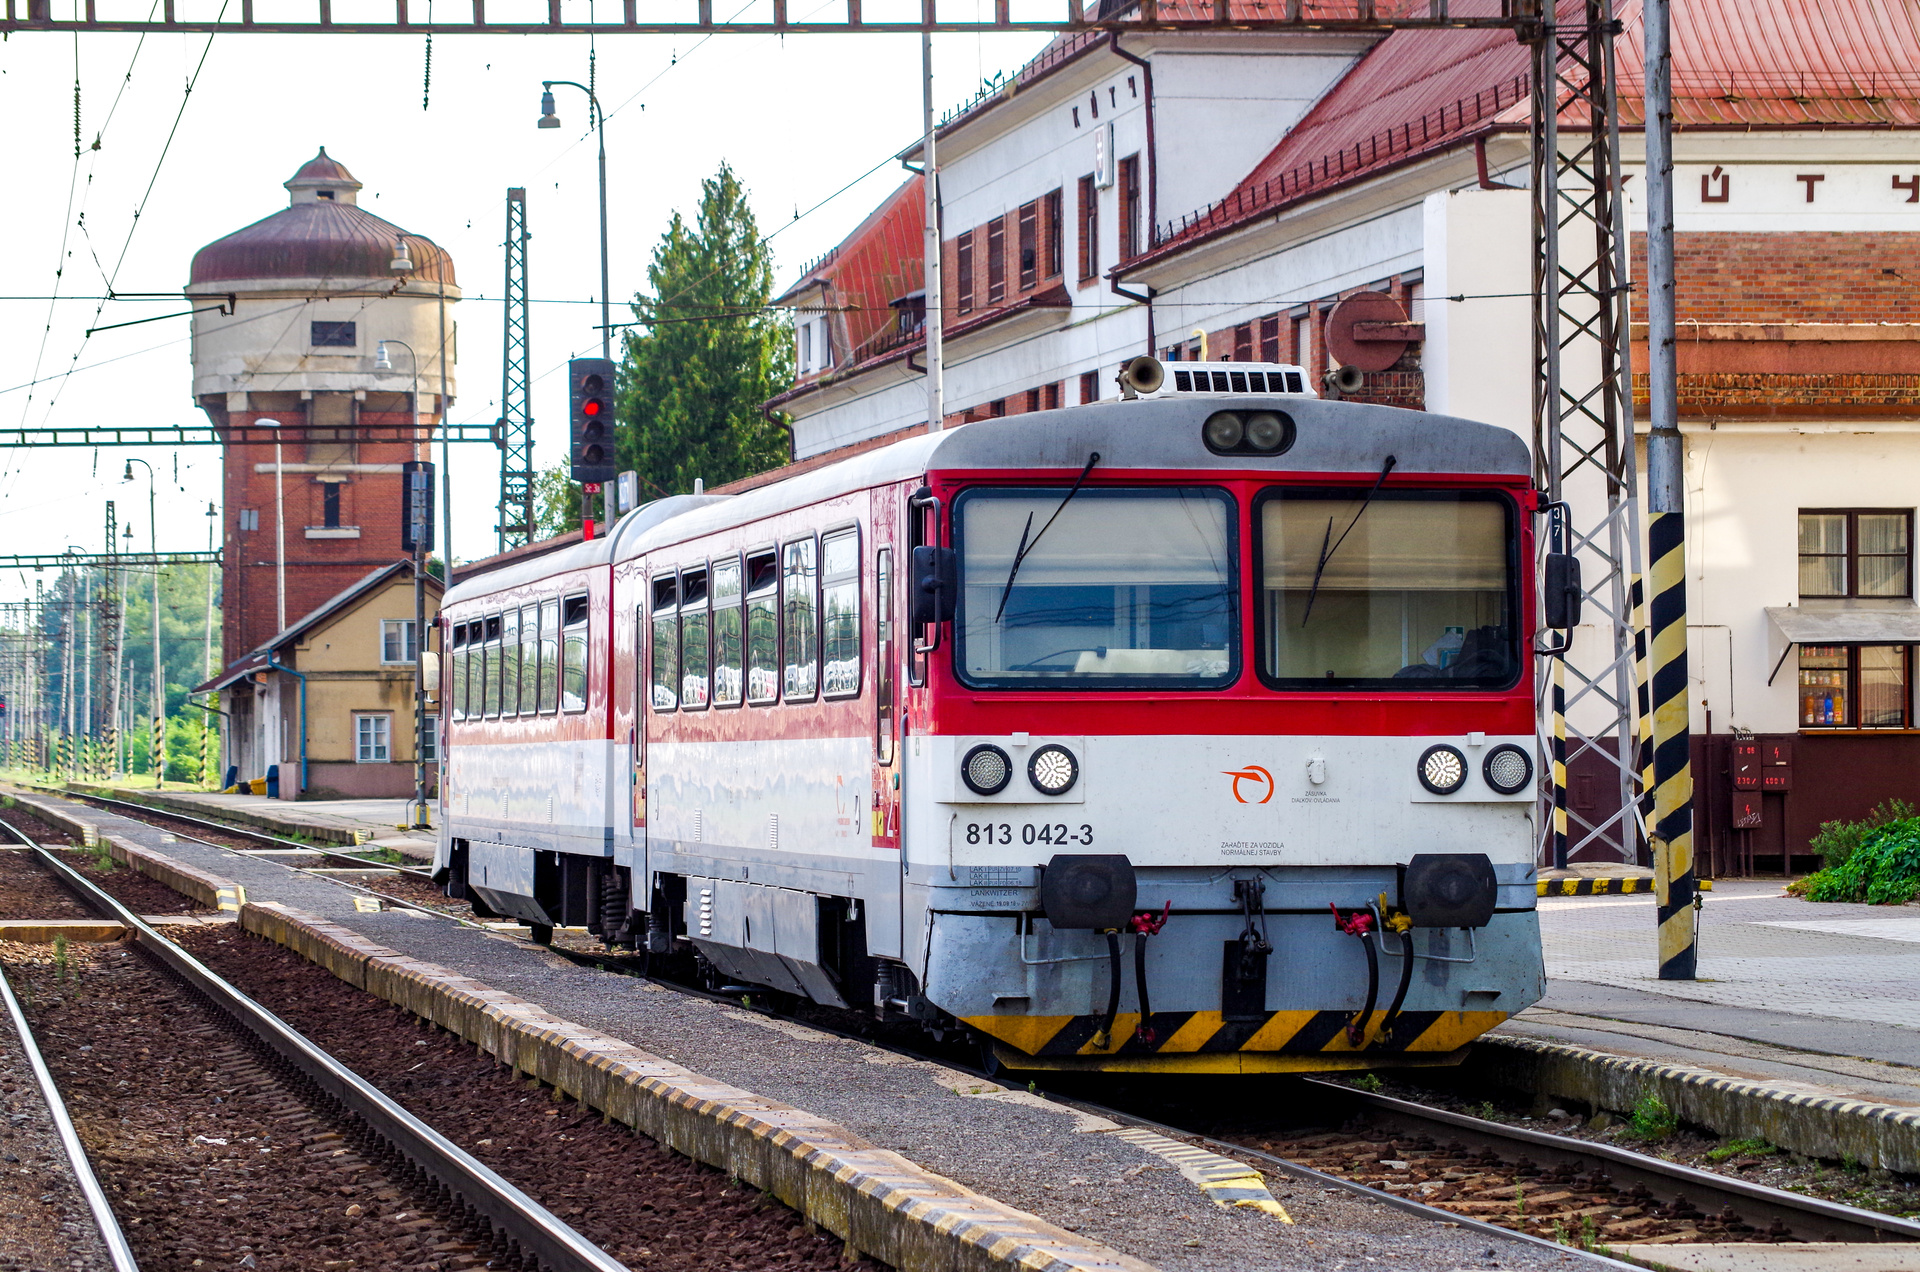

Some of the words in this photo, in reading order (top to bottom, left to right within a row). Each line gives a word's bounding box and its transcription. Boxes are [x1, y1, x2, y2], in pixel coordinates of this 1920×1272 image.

[1072, 75, 1137, 128] KÚTY
[966, 823, 1012, 845] 813
[1022, 823, 1094, 846] 042-3
